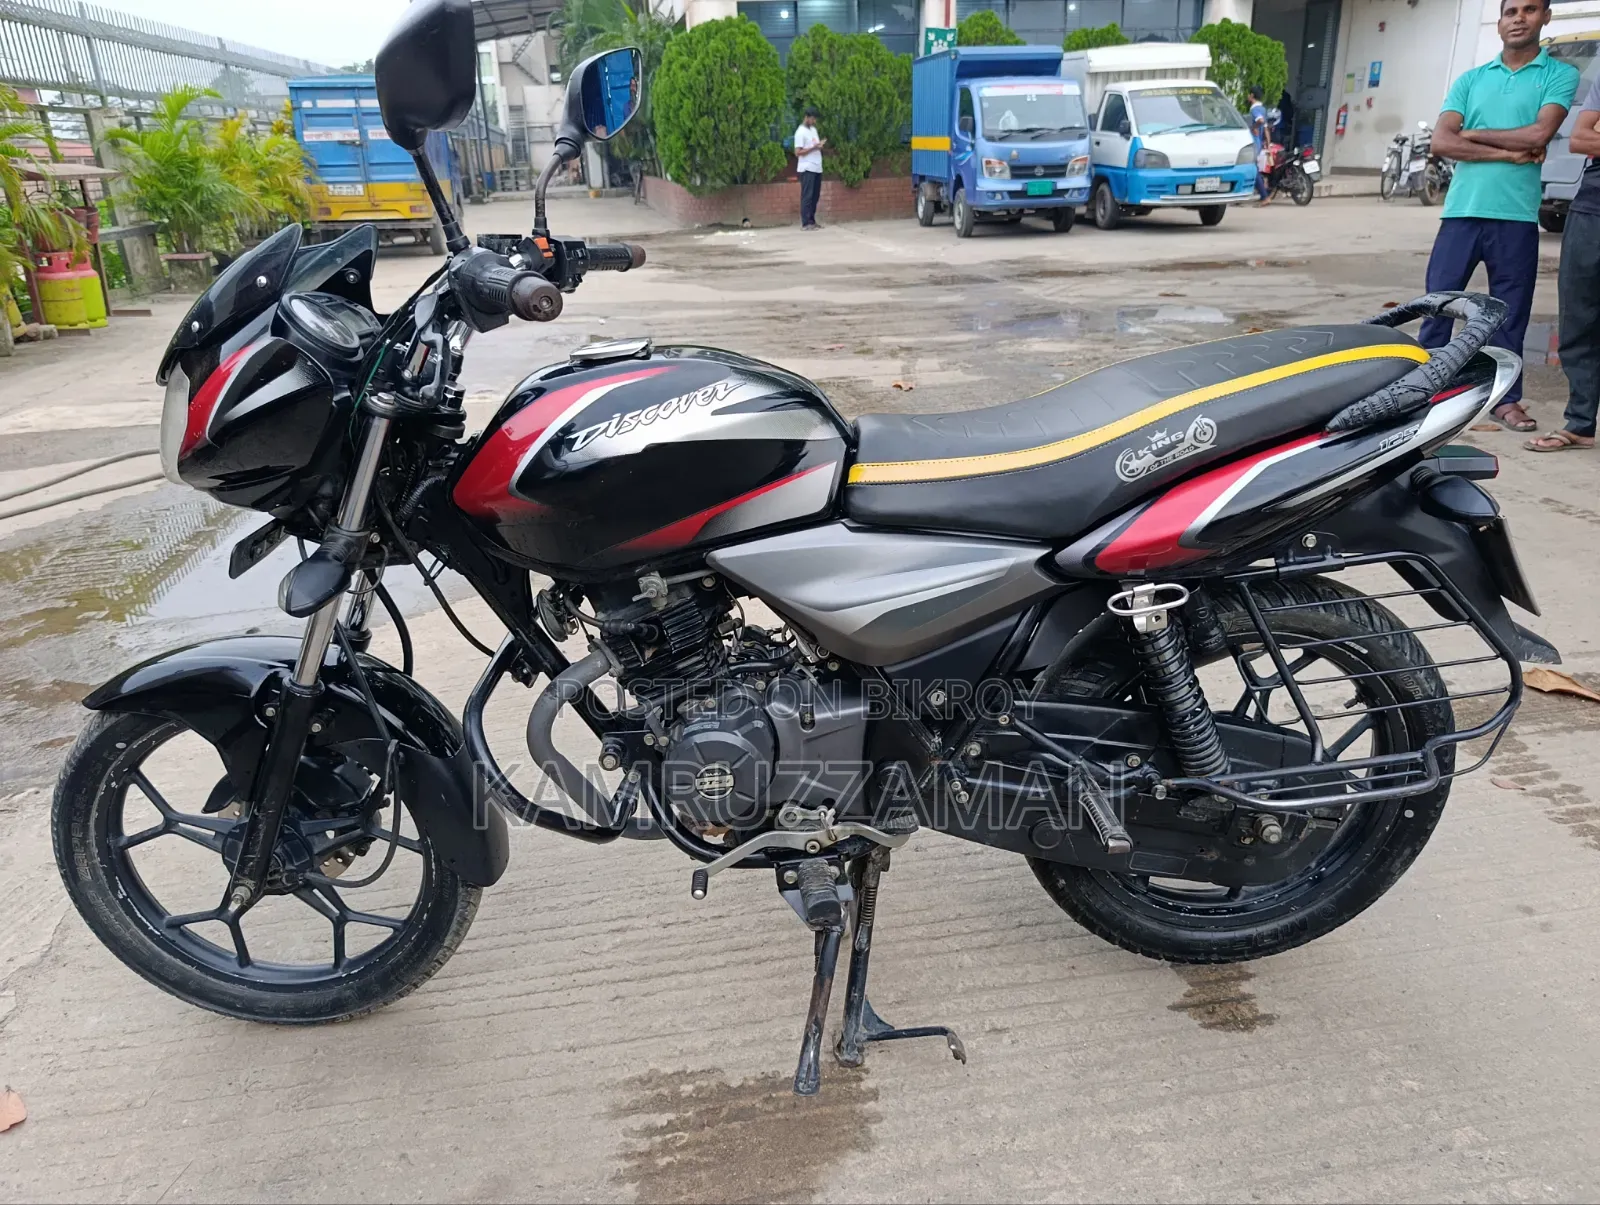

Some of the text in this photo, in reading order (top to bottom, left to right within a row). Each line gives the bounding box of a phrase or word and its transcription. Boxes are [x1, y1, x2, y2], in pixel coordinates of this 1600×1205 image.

[566, 382, 747, 451] Discover
[1138, 431, 1185, 457] KING
[1149, 446, 1195, 471] OF THE ROAD
